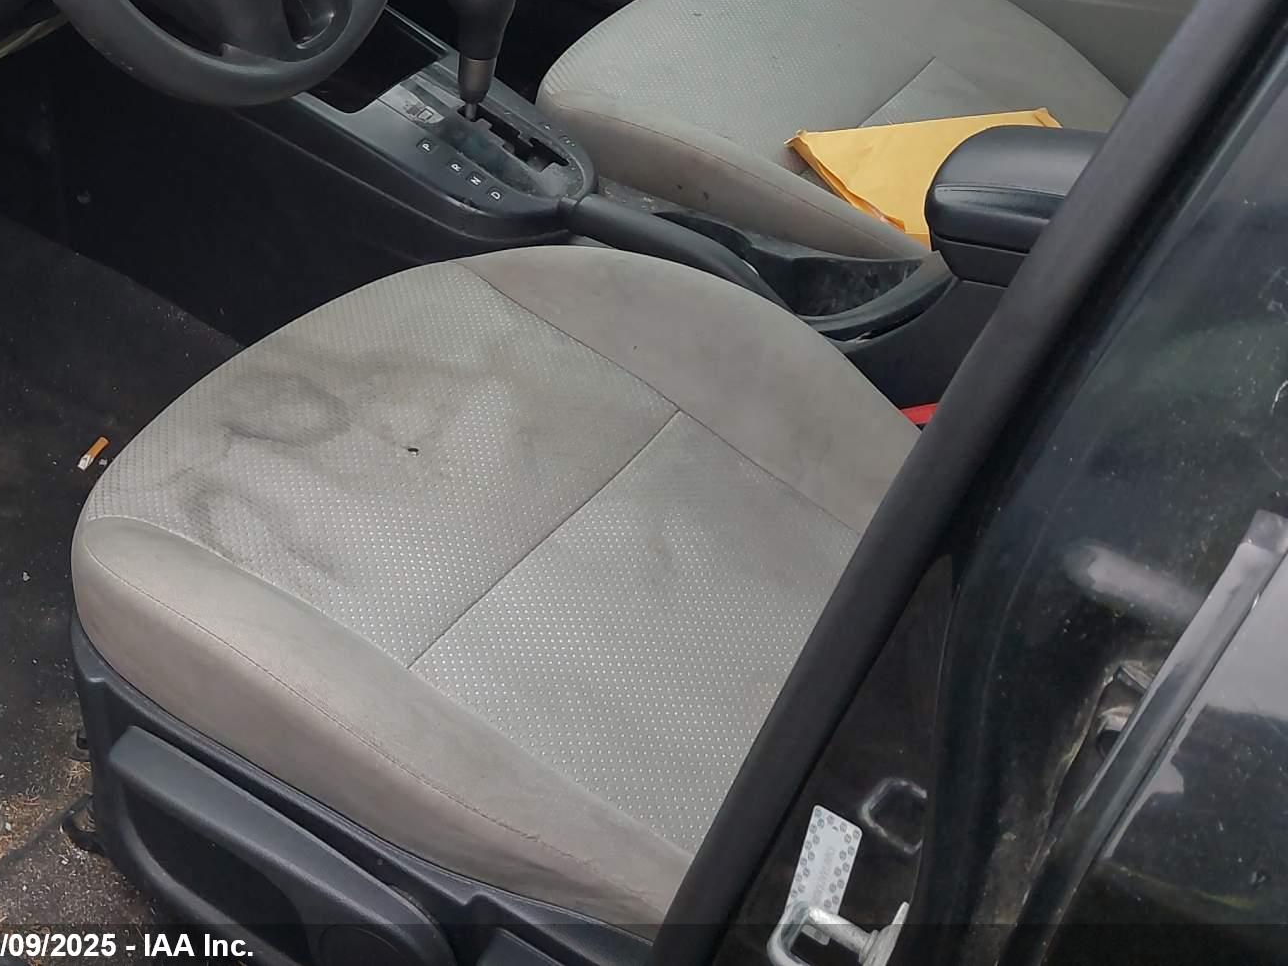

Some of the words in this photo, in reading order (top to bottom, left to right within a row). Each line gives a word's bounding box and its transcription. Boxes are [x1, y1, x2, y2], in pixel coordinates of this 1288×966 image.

[422, 143, 431, 151] P
[451, 163, 462, 171] R
[470, 176, 481, 186] N
[491, 191, 501, 200] D
